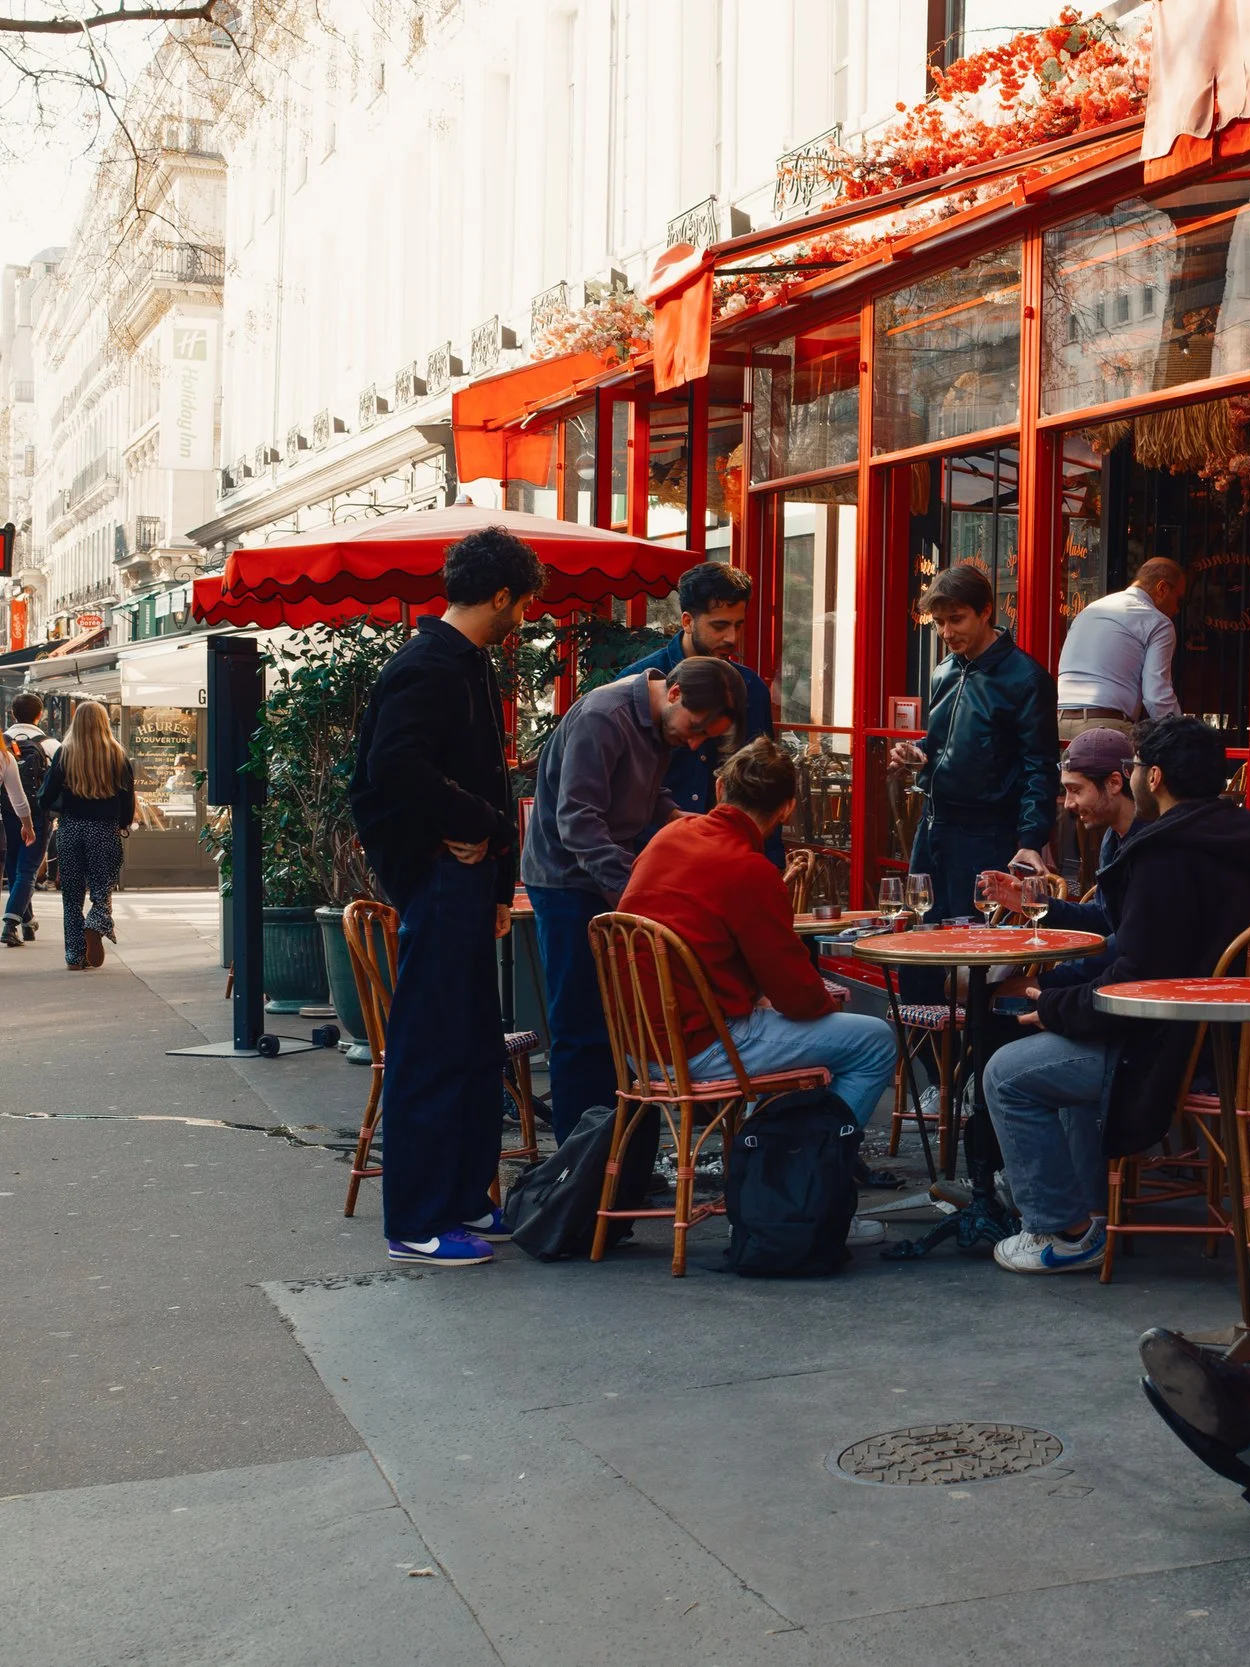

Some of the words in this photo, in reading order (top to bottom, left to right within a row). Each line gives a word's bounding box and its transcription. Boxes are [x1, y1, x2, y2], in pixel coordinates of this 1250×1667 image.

[177, 366, 199, 430] Holiday
[180, 432, 197, 458] Inn
[1061, 533, 1088, 562] Music
[198, 688, 206, 705] G
[137, 721, 189, 736] HEURES
